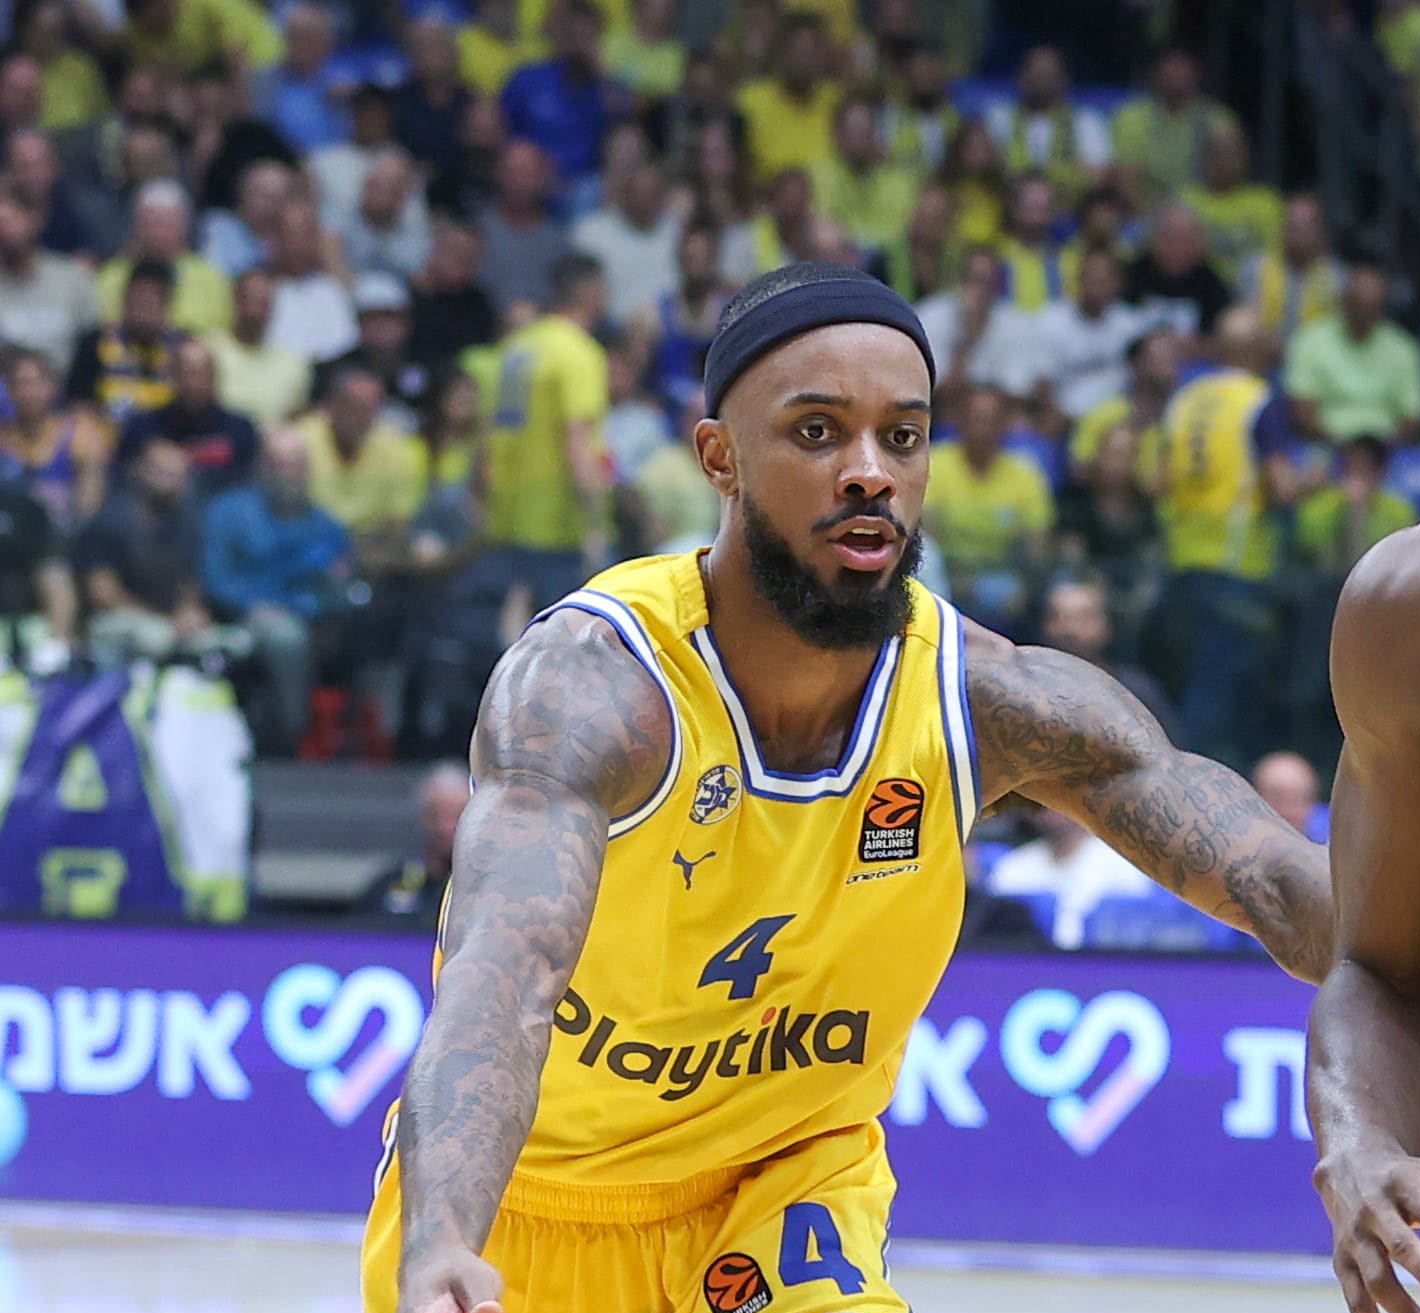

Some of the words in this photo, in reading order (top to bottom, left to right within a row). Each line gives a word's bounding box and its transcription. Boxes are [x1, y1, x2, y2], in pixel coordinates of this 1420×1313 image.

[863, 848, 914, 860] EuroLeague
[864, 828, 914, 840] TURKISH
[864, 838, 914, 851] AIRLINES
[696, 913, 798, 1001] 4
[553, 986, 870, 1101] Playtika
[777, 1201, 868, 1297] 4
